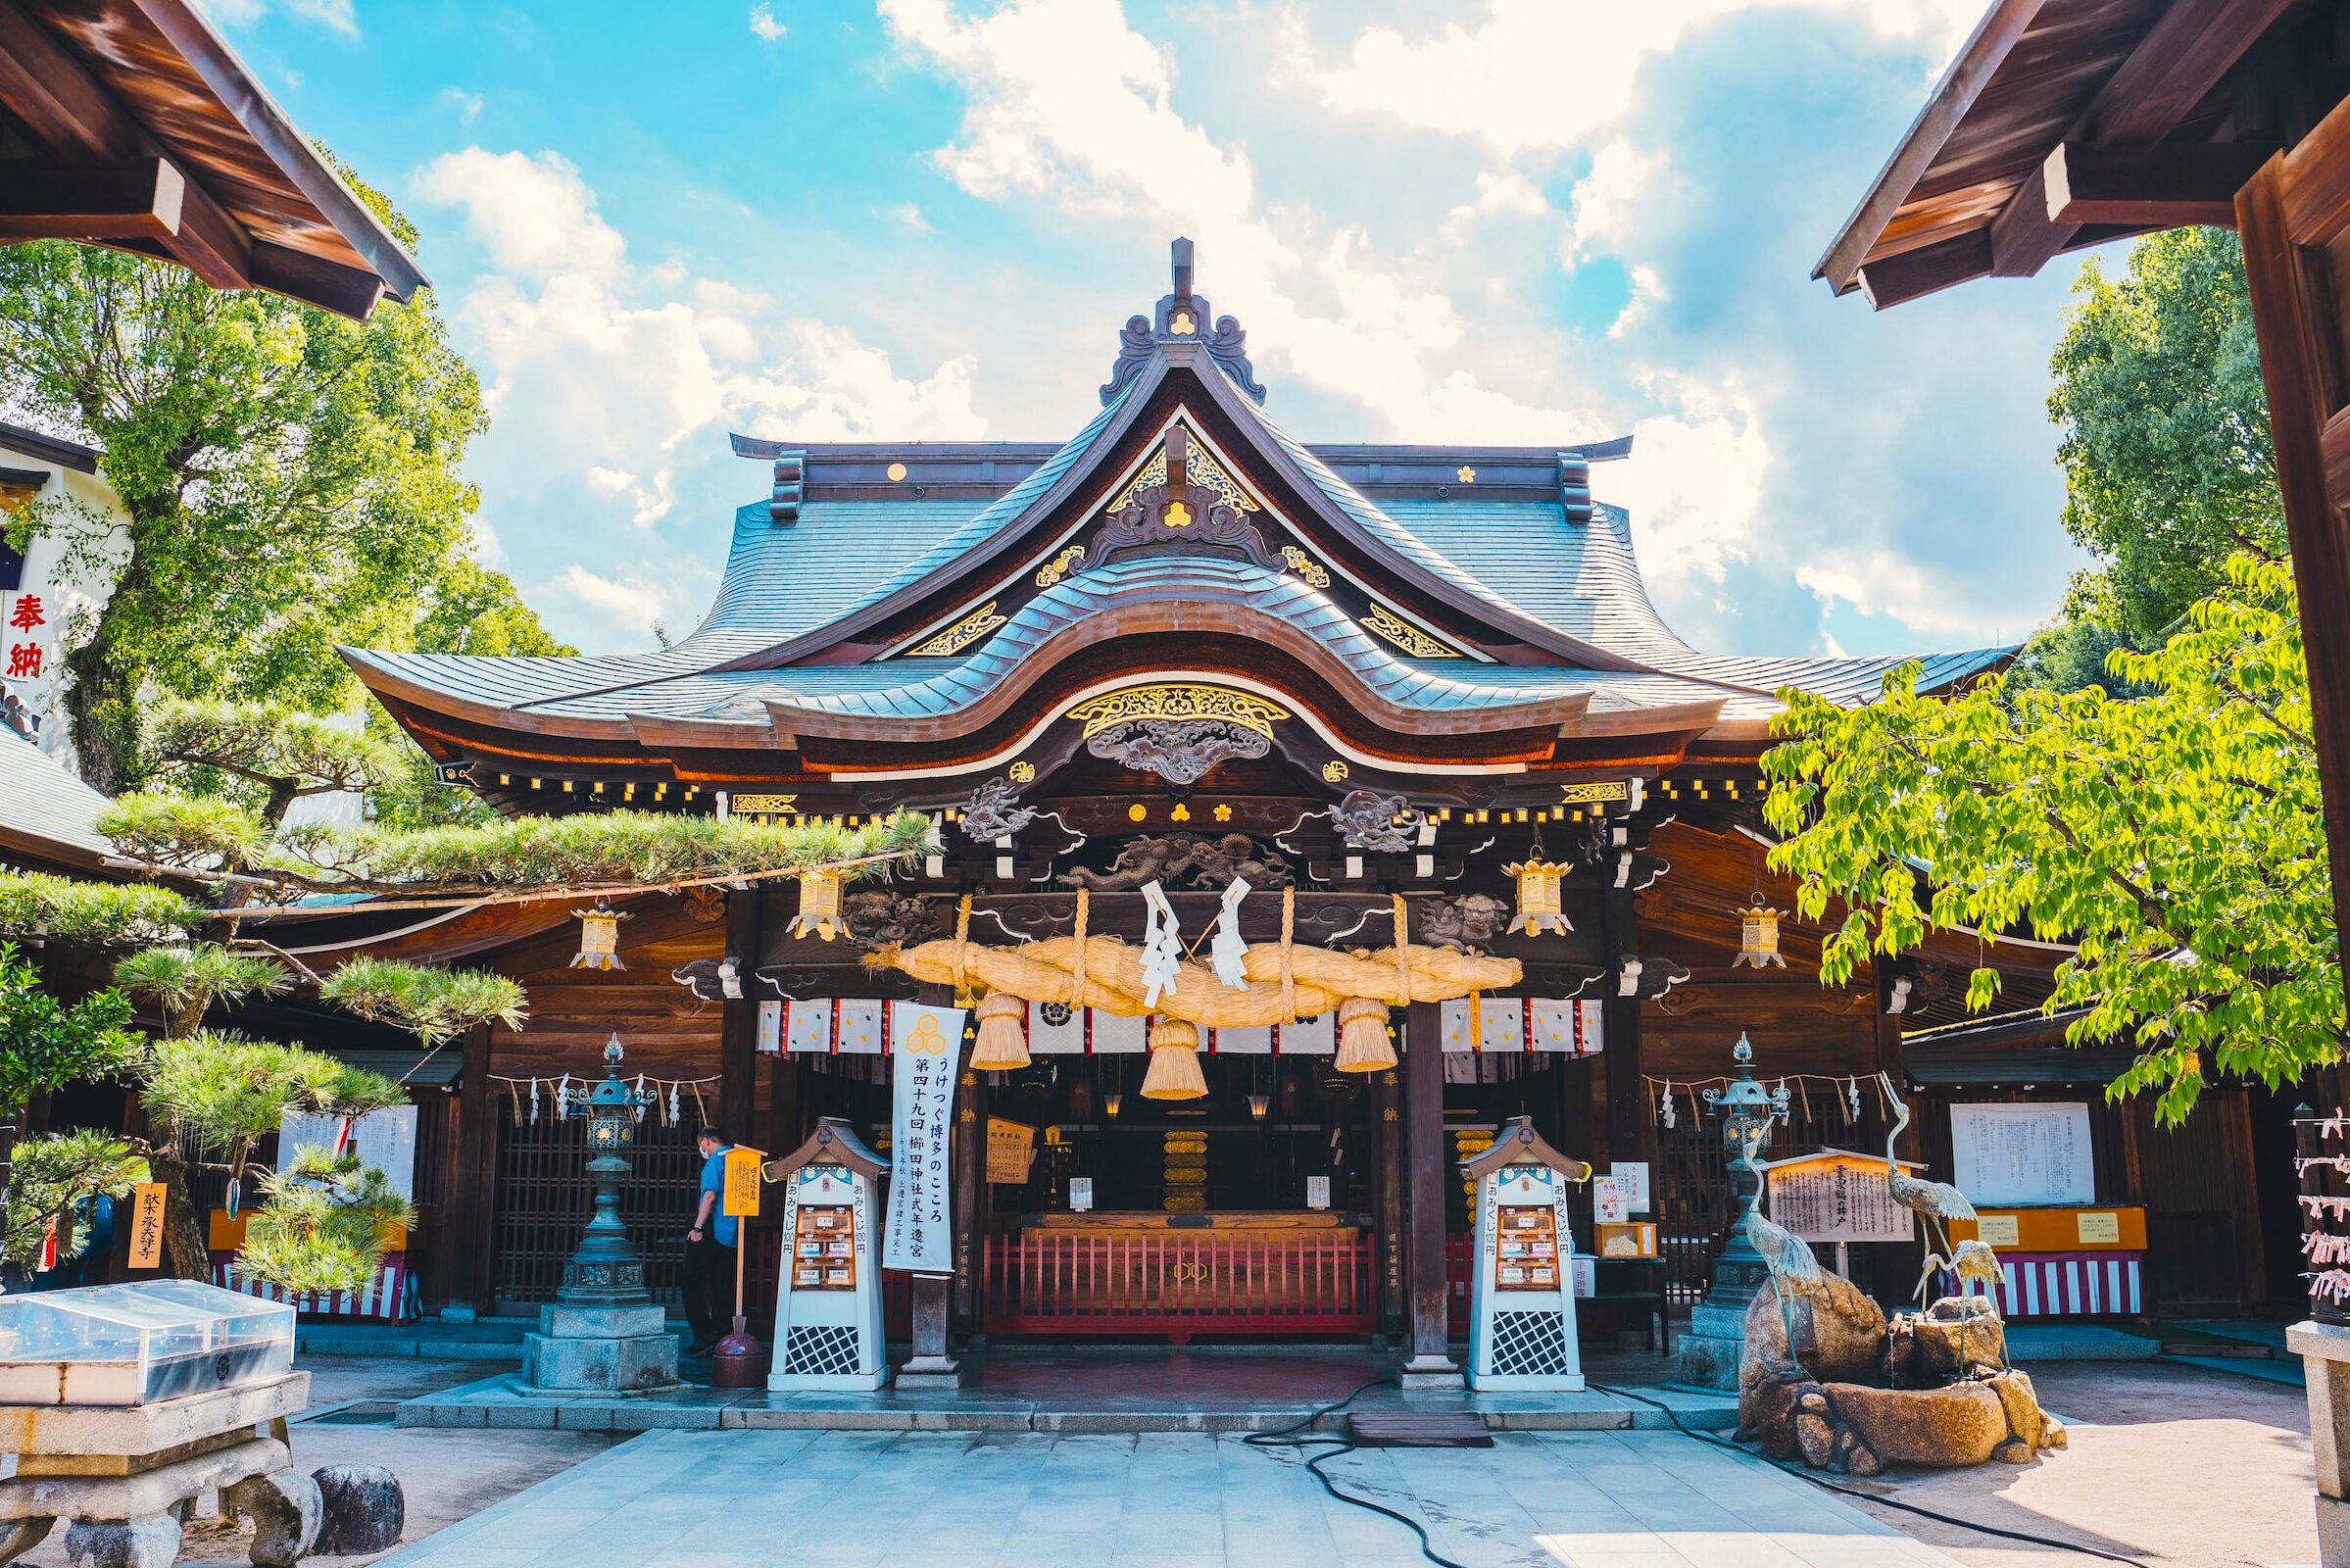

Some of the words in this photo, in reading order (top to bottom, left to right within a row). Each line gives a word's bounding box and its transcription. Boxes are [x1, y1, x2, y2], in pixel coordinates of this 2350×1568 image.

[7, 594, 46, 678] 奉納
[1383, 1071, 1398, 1122] 奉納
[930, 1058, 949, 1223] うけつぐ博多のこころ
[783, 1185, 797, 1254] おみくじ100円
[854, 1185, 865, 1254] おみくじ100円
[1486, 1186, 1497, 1255] おみくじ100円
[1554, 1185, 1569, 1254] おみくじ100円
[1577, 1260, 1586, 1297] 手指消毒
